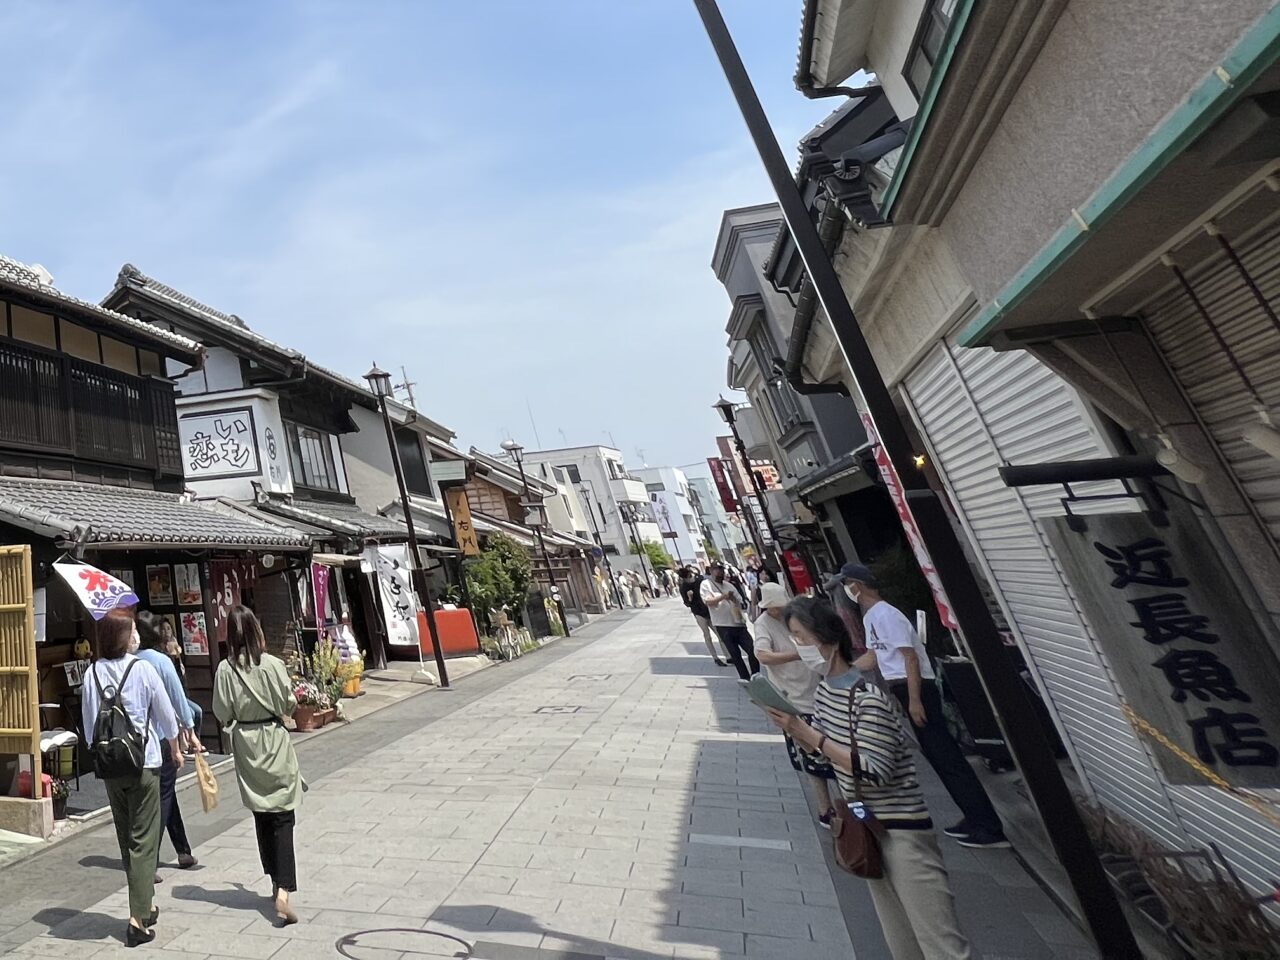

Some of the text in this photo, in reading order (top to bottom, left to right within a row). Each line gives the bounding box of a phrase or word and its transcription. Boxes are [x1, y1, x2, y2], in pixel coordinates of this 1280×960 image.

[78, 568, 114, 592] 氷
[1093, 537, 1279, 768] 近長魚店
